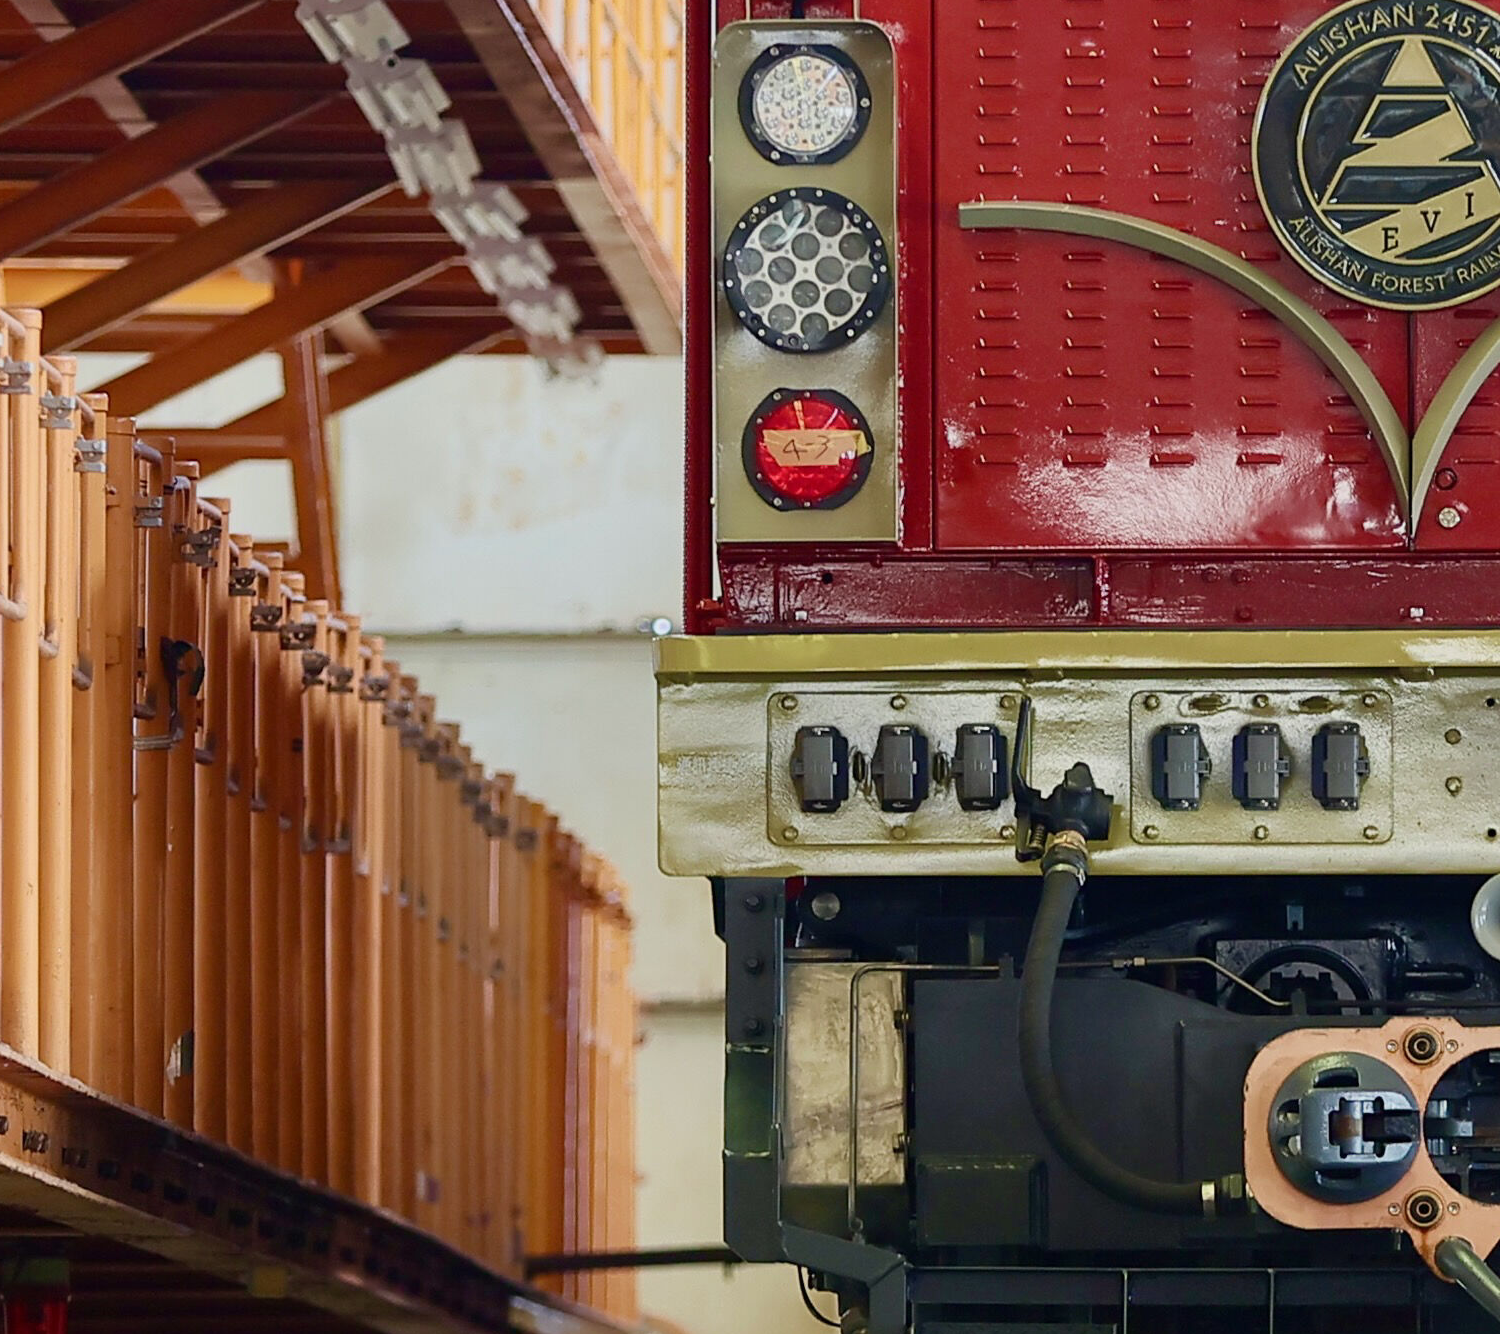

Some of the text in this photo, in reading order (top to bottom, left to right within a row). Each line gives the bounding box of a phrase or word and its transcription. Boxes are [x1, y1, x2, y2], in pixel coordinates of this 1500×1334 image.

[1295, 2, 1415, 85] ALISHAN
[1424, 5, 1492, 45] 2451
[1289, 217, 1368, 283] ALISHAN
[1370, 272, 1447, 295] FOREST
[1381, 191, 1475, 254] EVI
